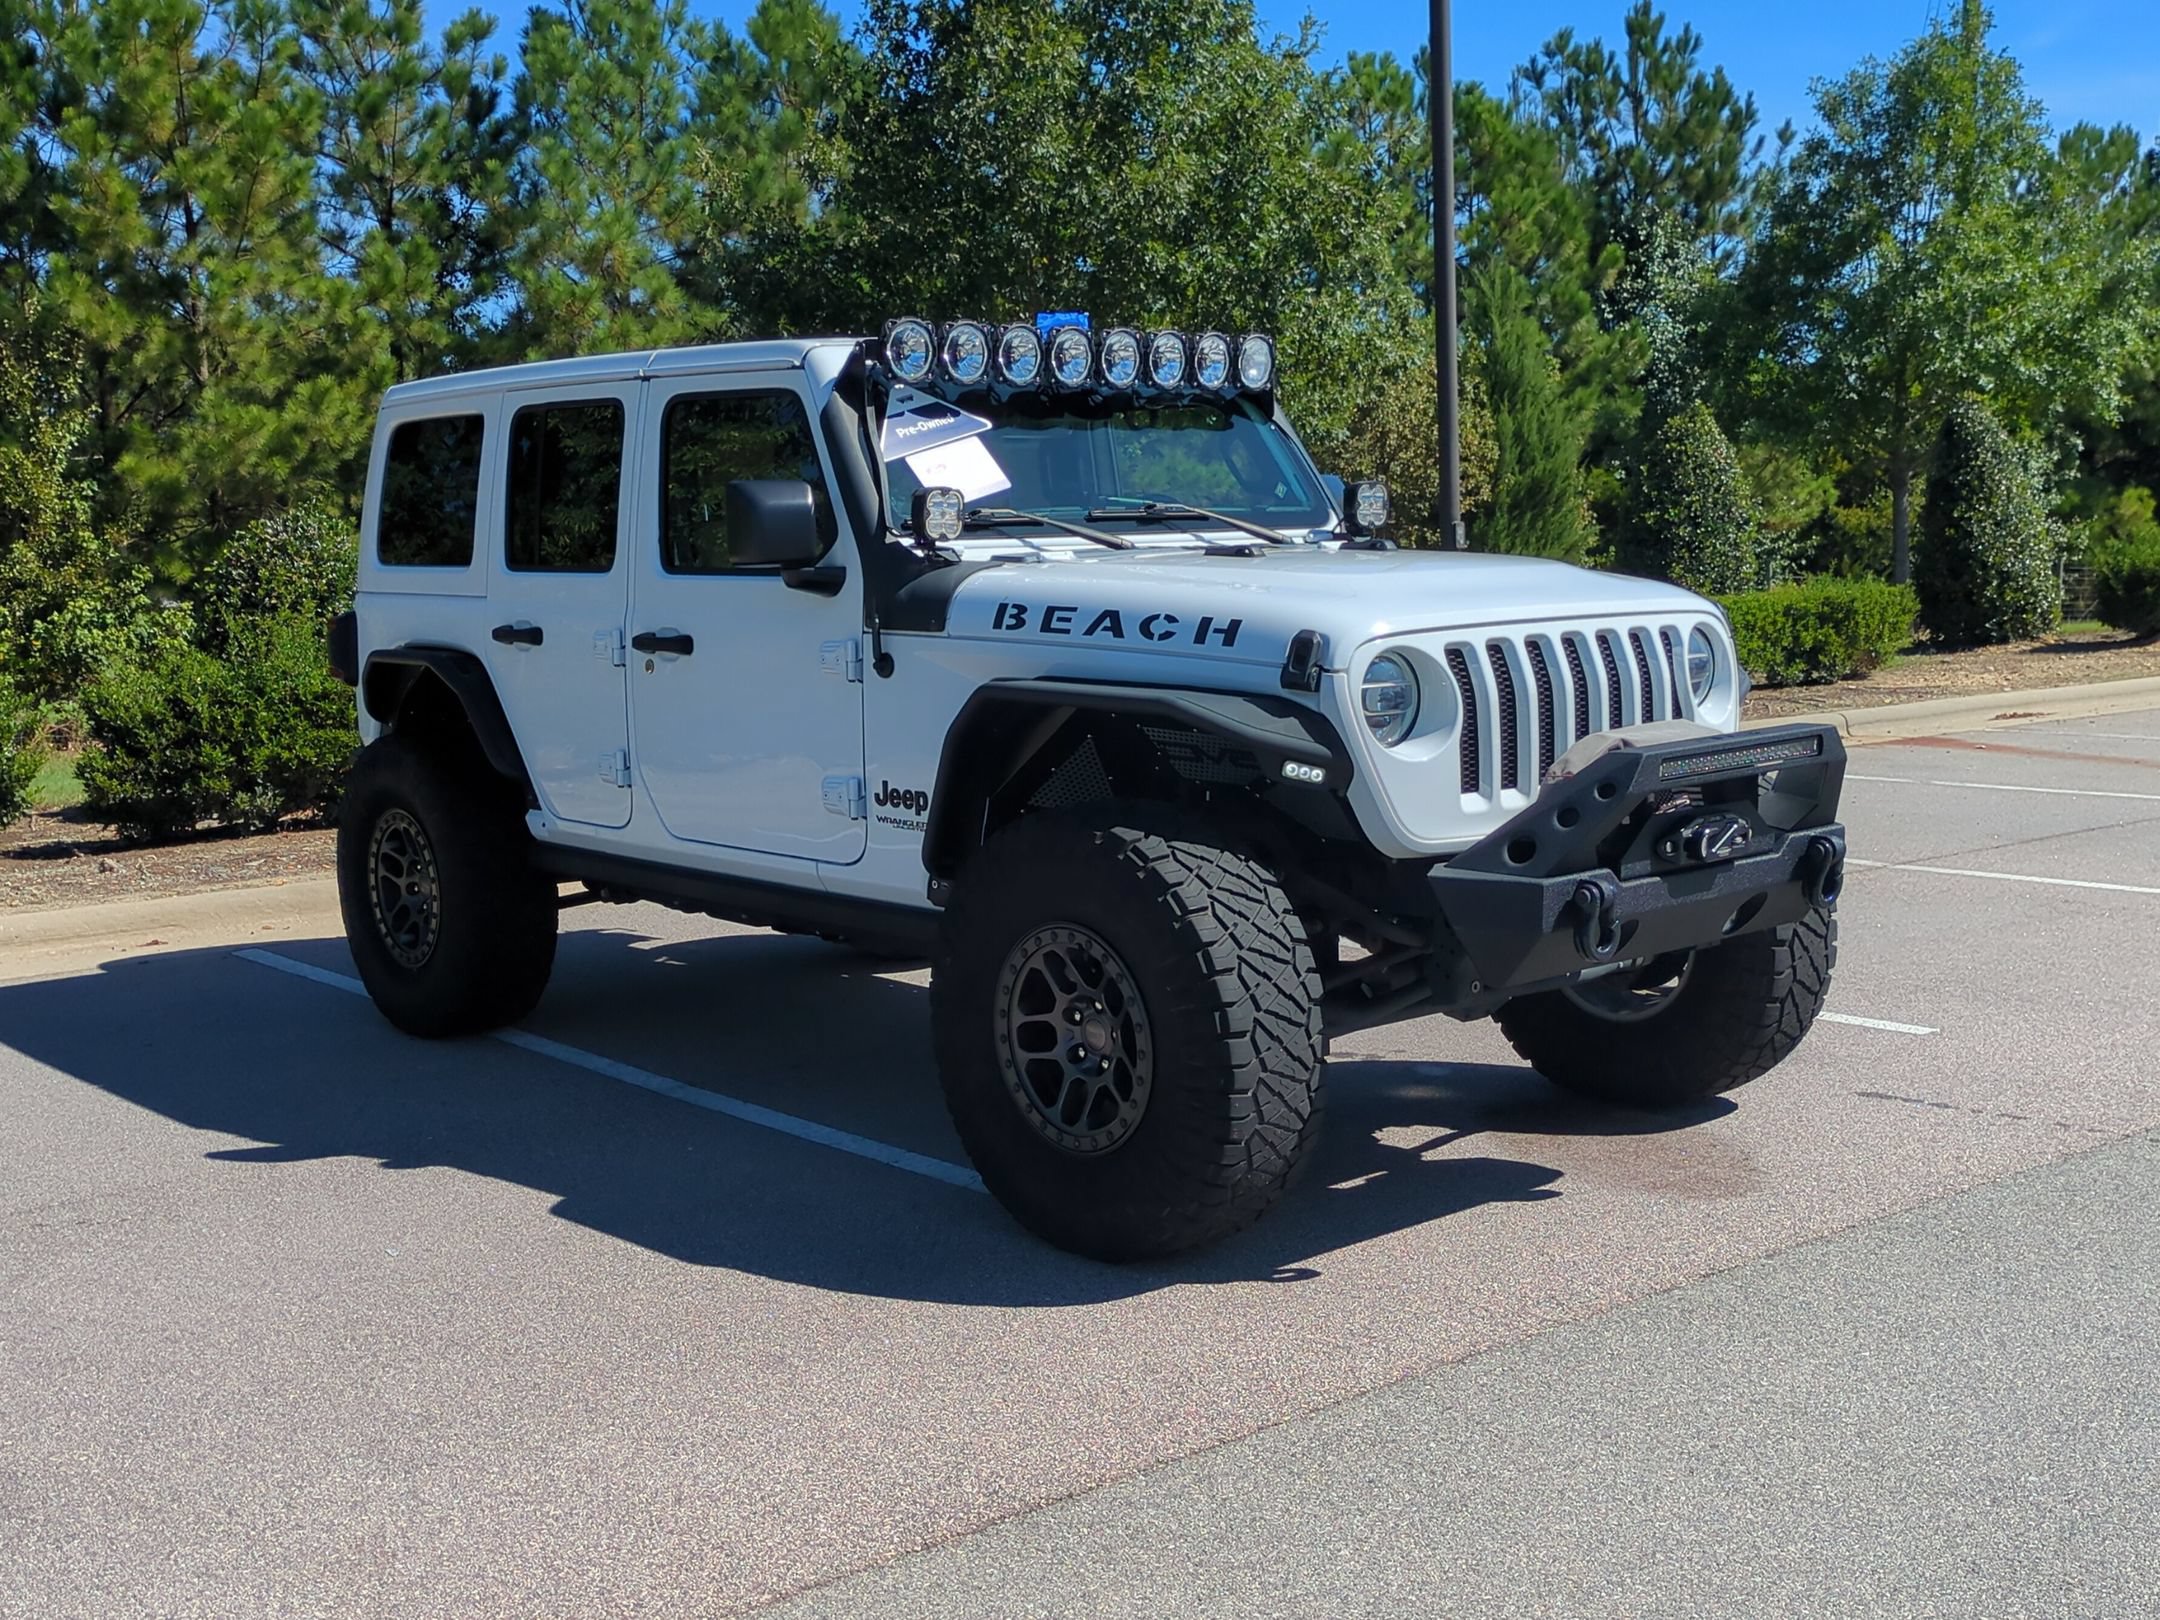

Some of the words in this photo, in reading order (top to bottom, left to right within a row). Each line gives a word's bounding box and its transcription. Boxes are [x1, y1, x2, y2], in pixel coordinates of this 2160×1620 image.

[895, 412, 956, 439] Pre-Owned
[991, 602, 1243, 648] BEACH
[874, 780, 929, 817] Jeep
